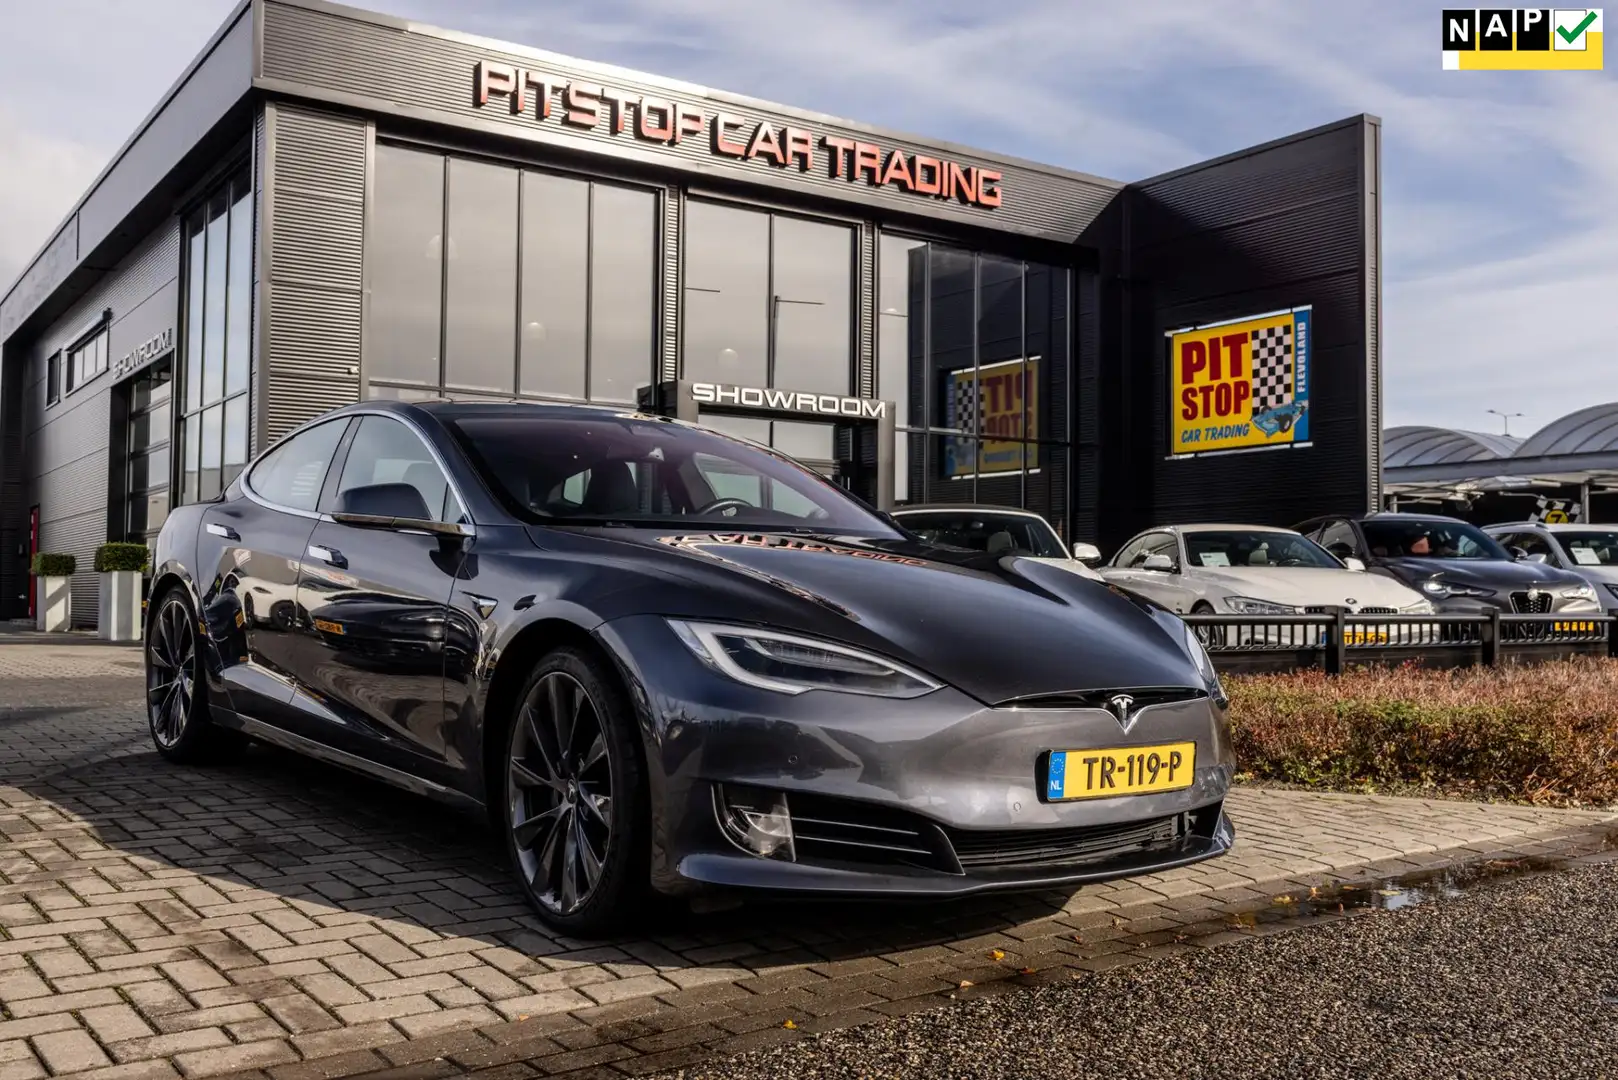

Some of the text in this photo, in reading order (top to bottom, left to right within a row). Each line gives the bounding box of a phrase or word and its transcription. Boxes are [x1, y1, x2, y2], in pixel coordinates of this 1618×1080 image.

[476, 60, 1001, 209] PITSTOP CAR TRADING
[112, 327, 173, 380] SHOWROOM
[1181, 332, 1249, 385] PIT
[1297, 321, 1307, 393] FLEVOLAND
[692, 382, 886, 418] SHOWROOM
[1181, 380, 1250, 422] STOP
[1181, 422, 1250, 443] CAR TRADING
[1050, 779, 1062, 790] NL
[1083, 751, 1182, 790] TR-119-P
